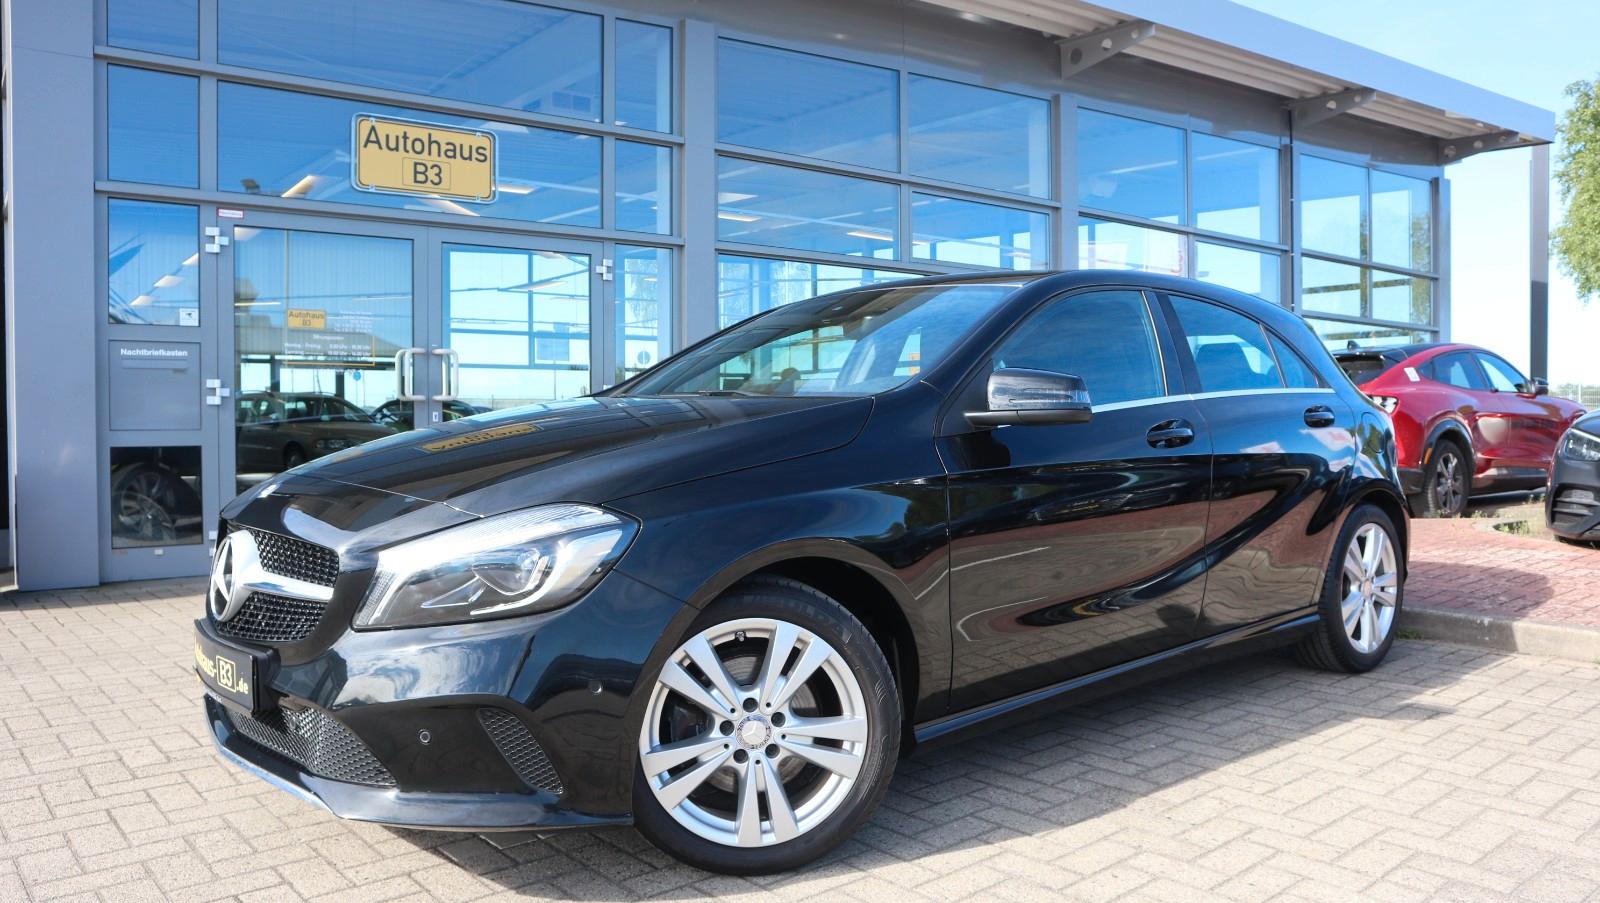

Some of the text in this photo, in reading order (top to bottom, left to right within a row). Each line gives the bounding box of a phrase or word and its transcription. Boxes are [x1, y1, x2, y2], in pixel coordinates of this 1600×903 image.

[363, 125, 488, 163] Autohaus
[413, 161, 443, 186] B3
[288, 311, 325, 319] Autohaus
[120, 348, 188, 357] Nachtbriefkasten
